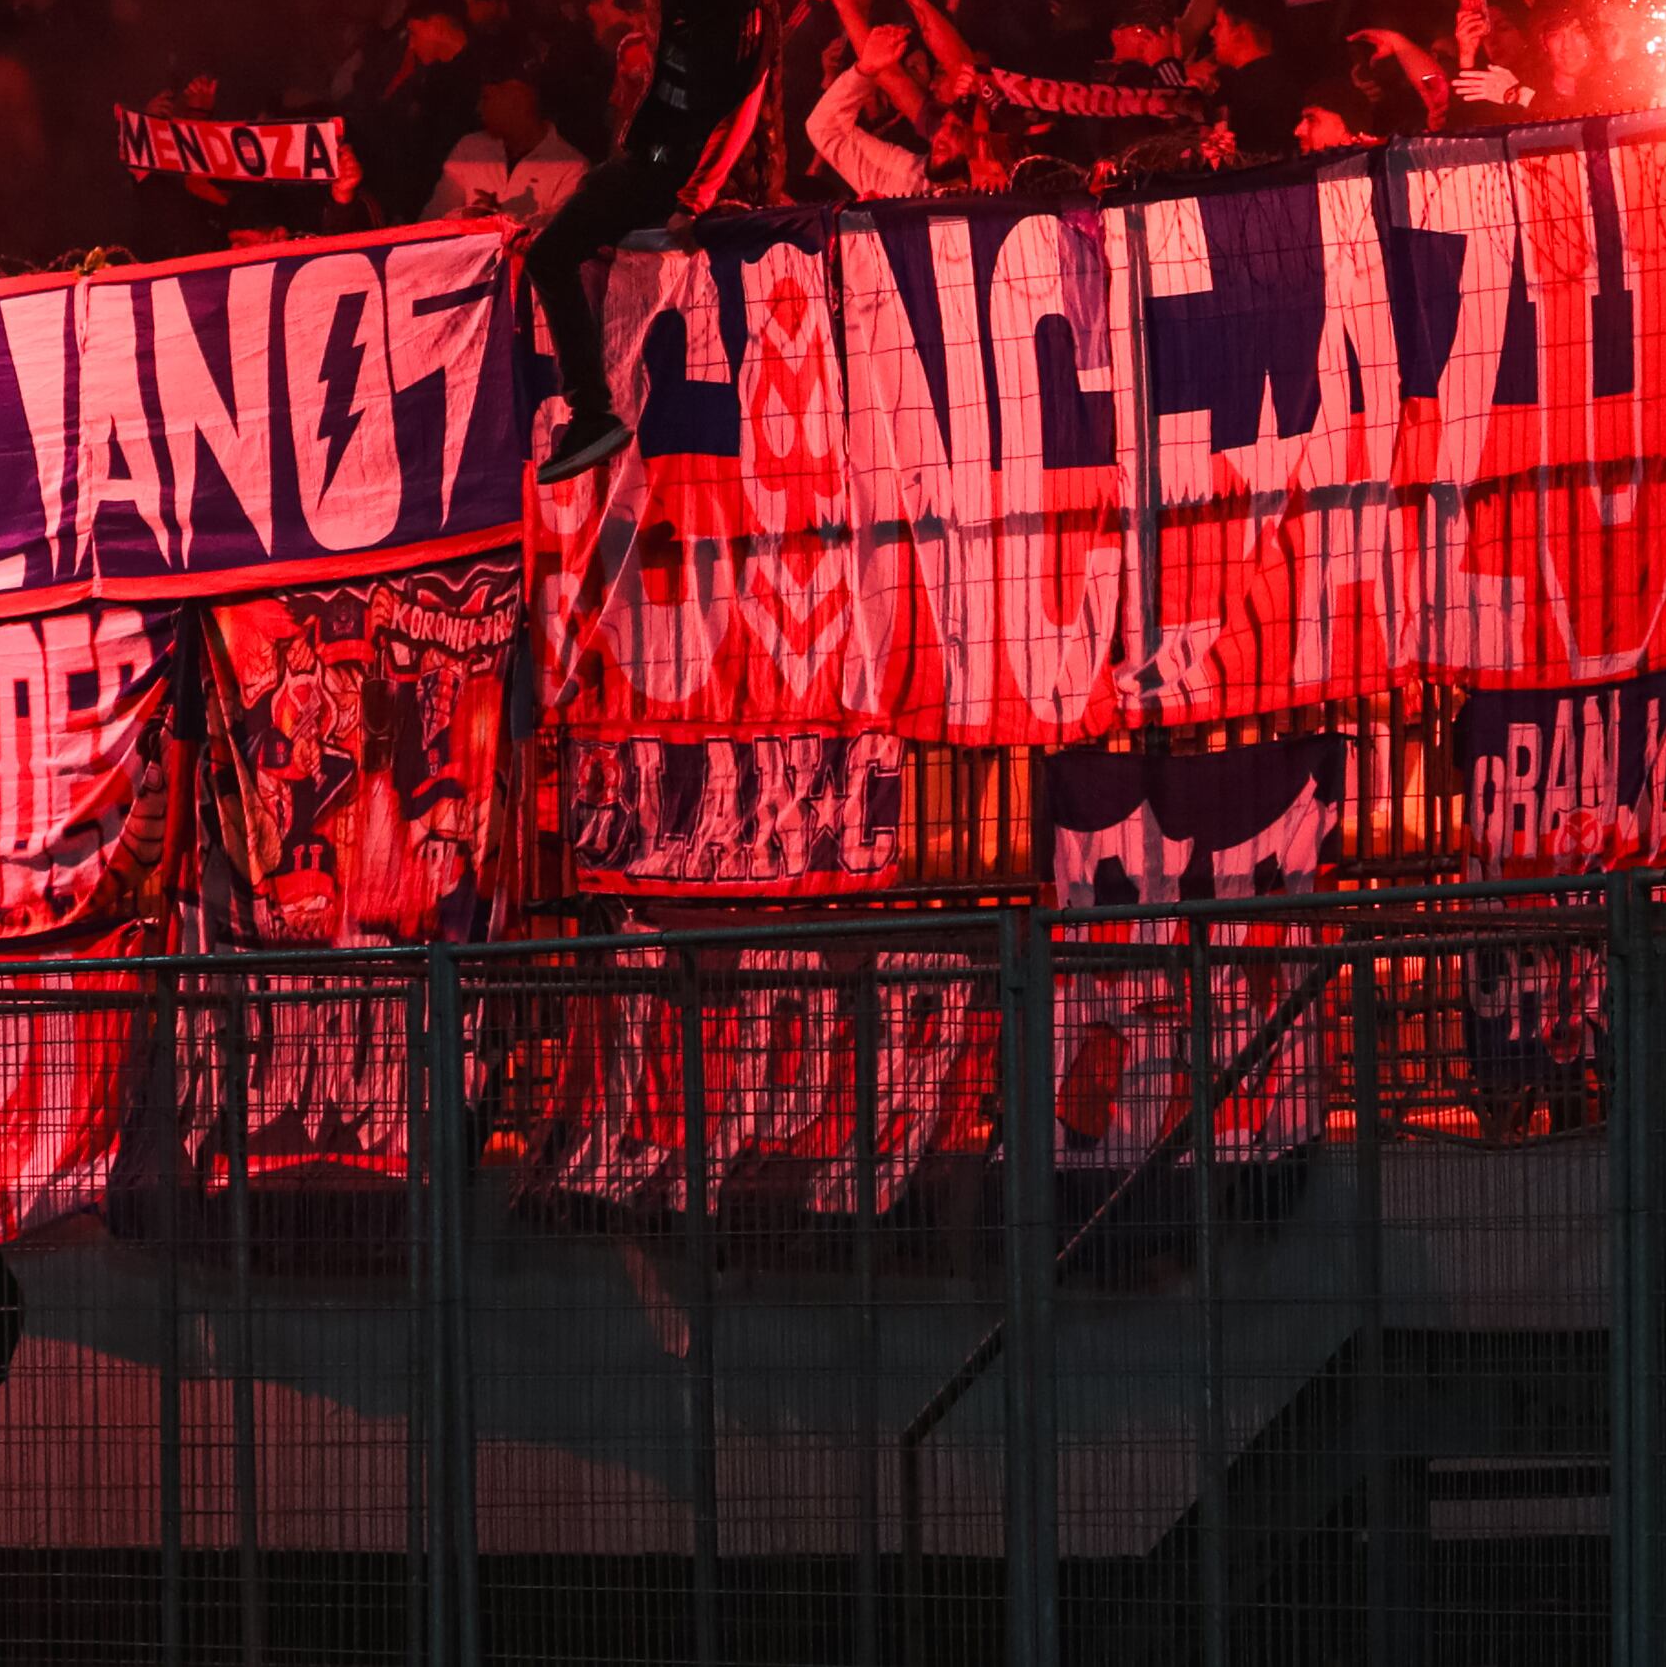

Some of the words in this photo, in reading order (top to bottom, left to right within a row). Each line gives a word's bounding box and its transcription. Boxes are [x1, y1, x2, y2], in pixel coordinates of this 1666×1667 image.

[992, 66, 1199, 123] KORONE
[124, 108, 334, 180] MENDOZA
[390, 602, 478, 652] KORONEL
